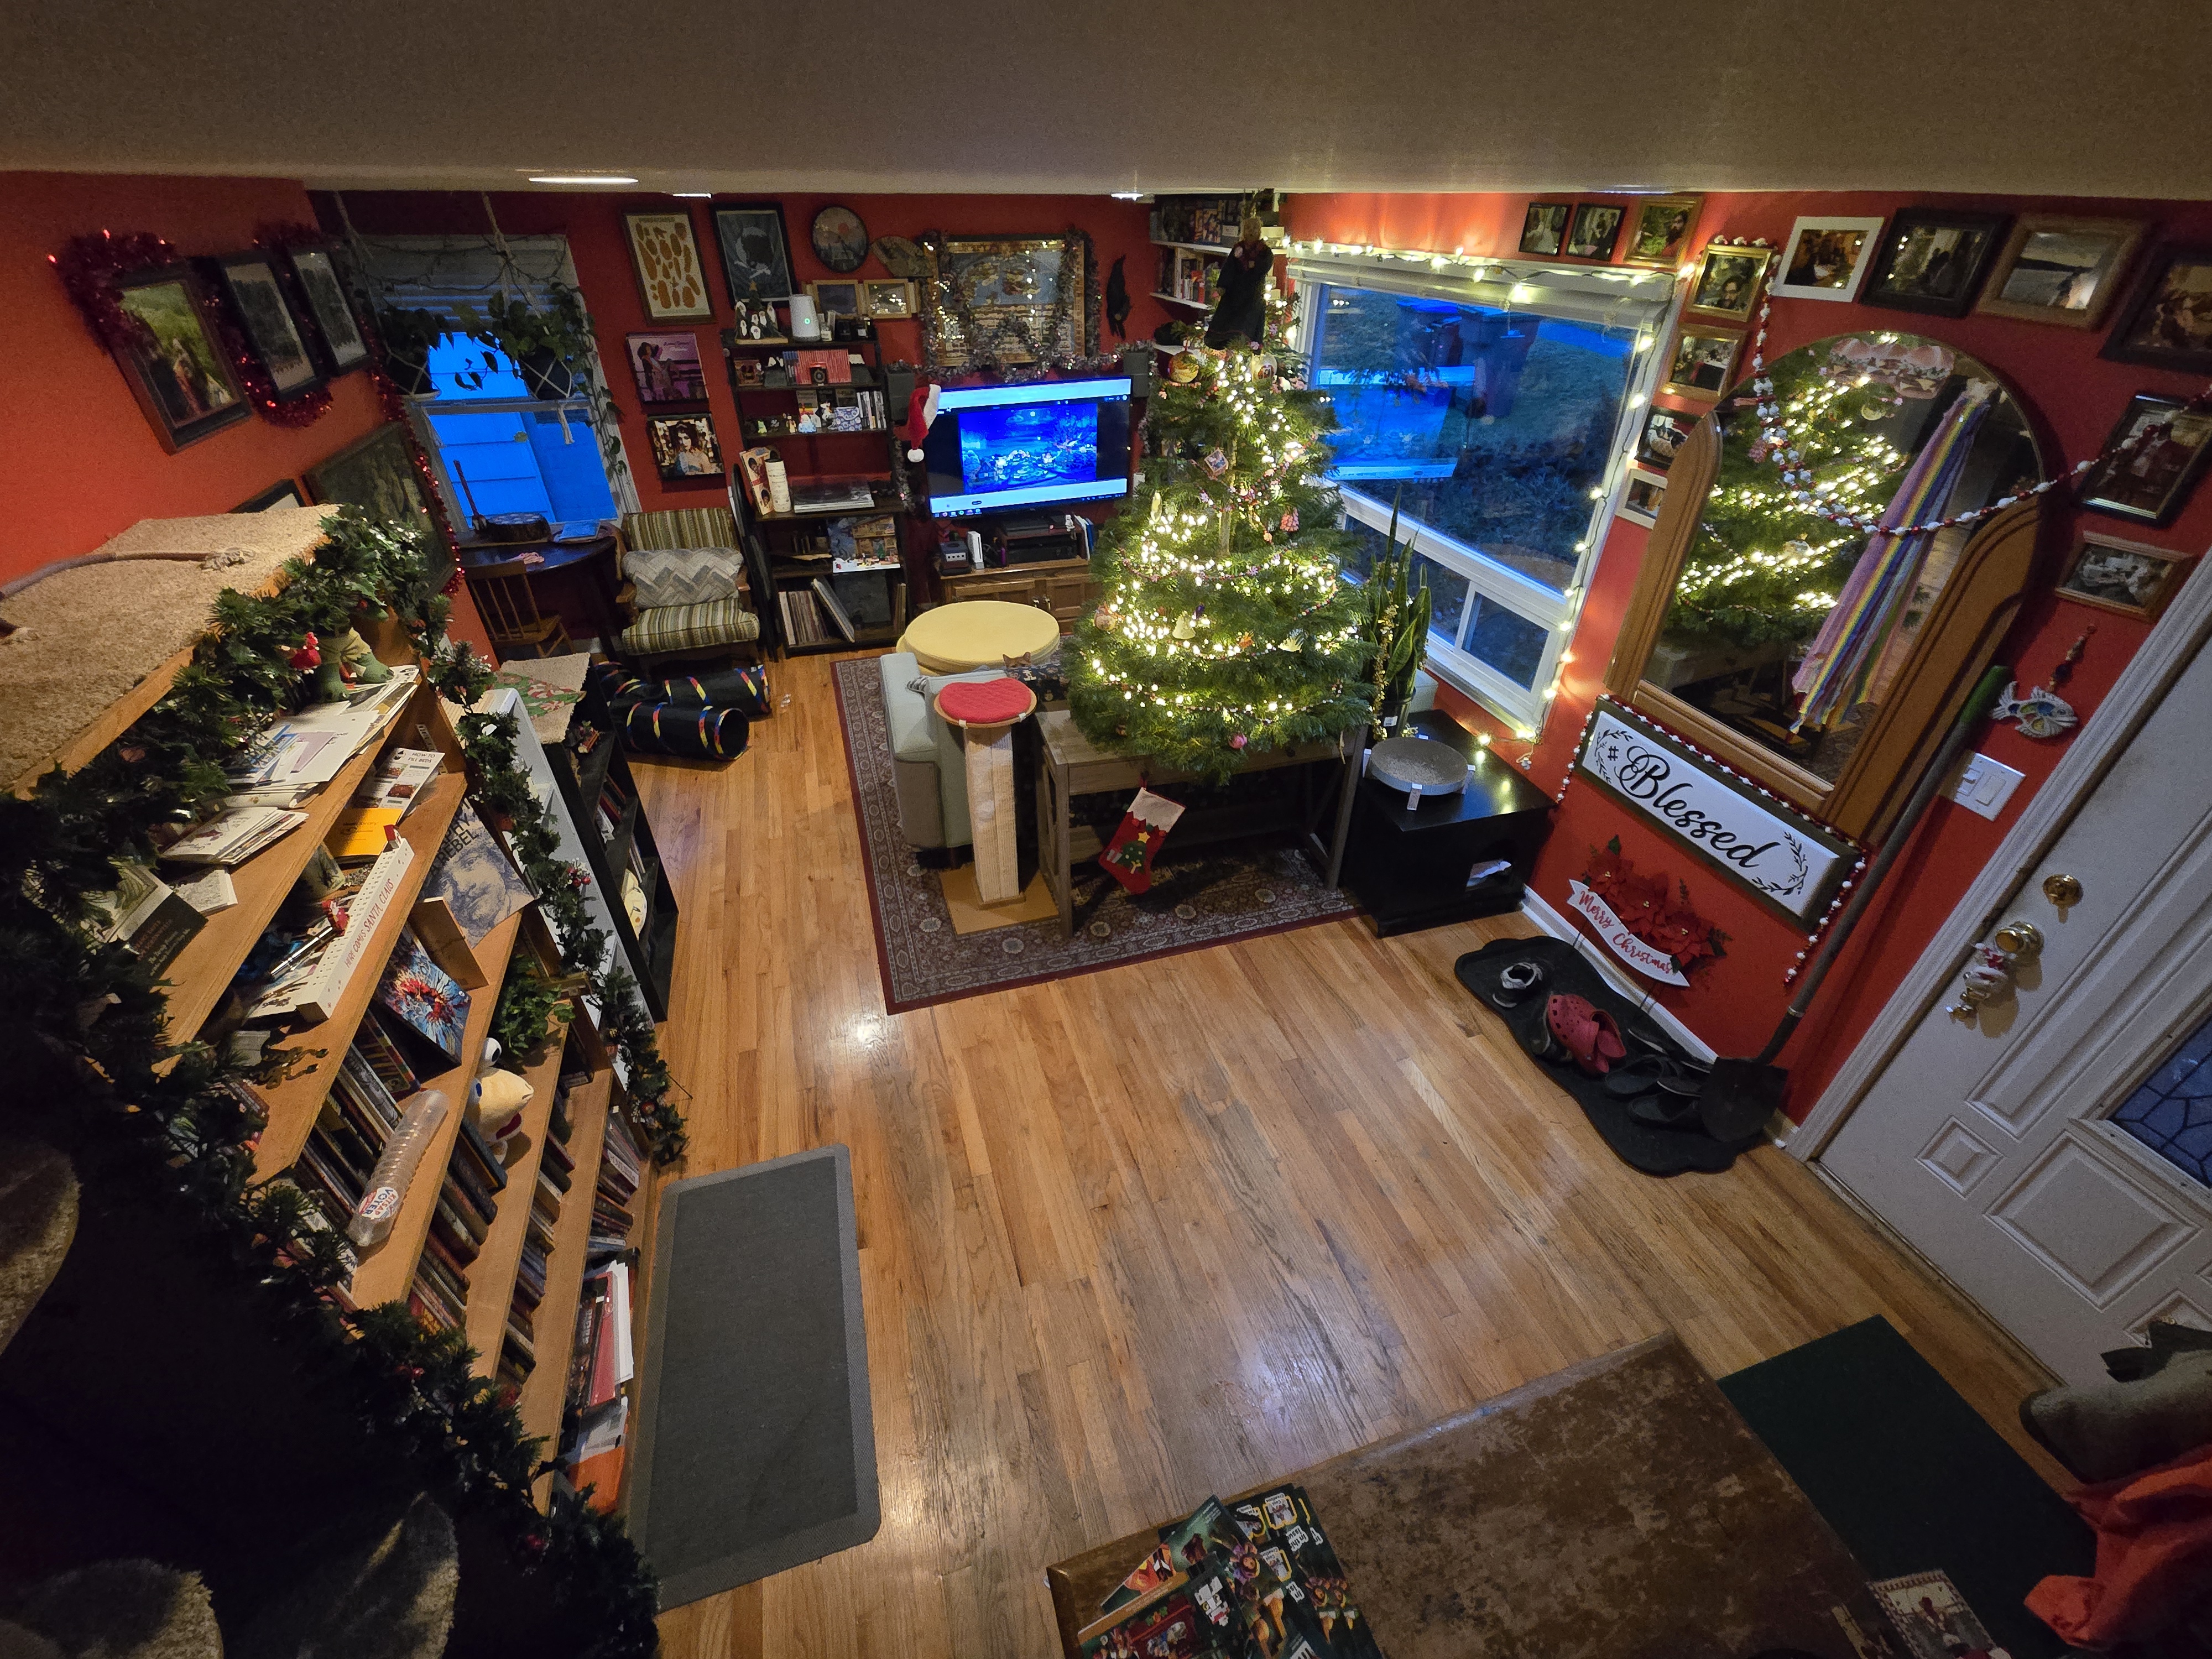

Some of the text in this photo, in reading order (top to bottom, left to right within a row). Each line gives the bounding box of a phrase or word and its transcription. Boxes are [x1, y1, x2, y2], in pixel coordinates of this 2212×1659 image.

[437, 830, 479, 861] REBEL
[363, 902, 384, 933] SANTA
[378, 878, 394, 904] CLAUS
[1578, 889, 1672, 975] Merry Christmas
[363, 1189, 393, 1214] VOTER
[375, 1193, 397, 1215] KITSAP
[1287, 1528, 1302, 1540] issu
[1290, 1538, 1301, 1549] thi
